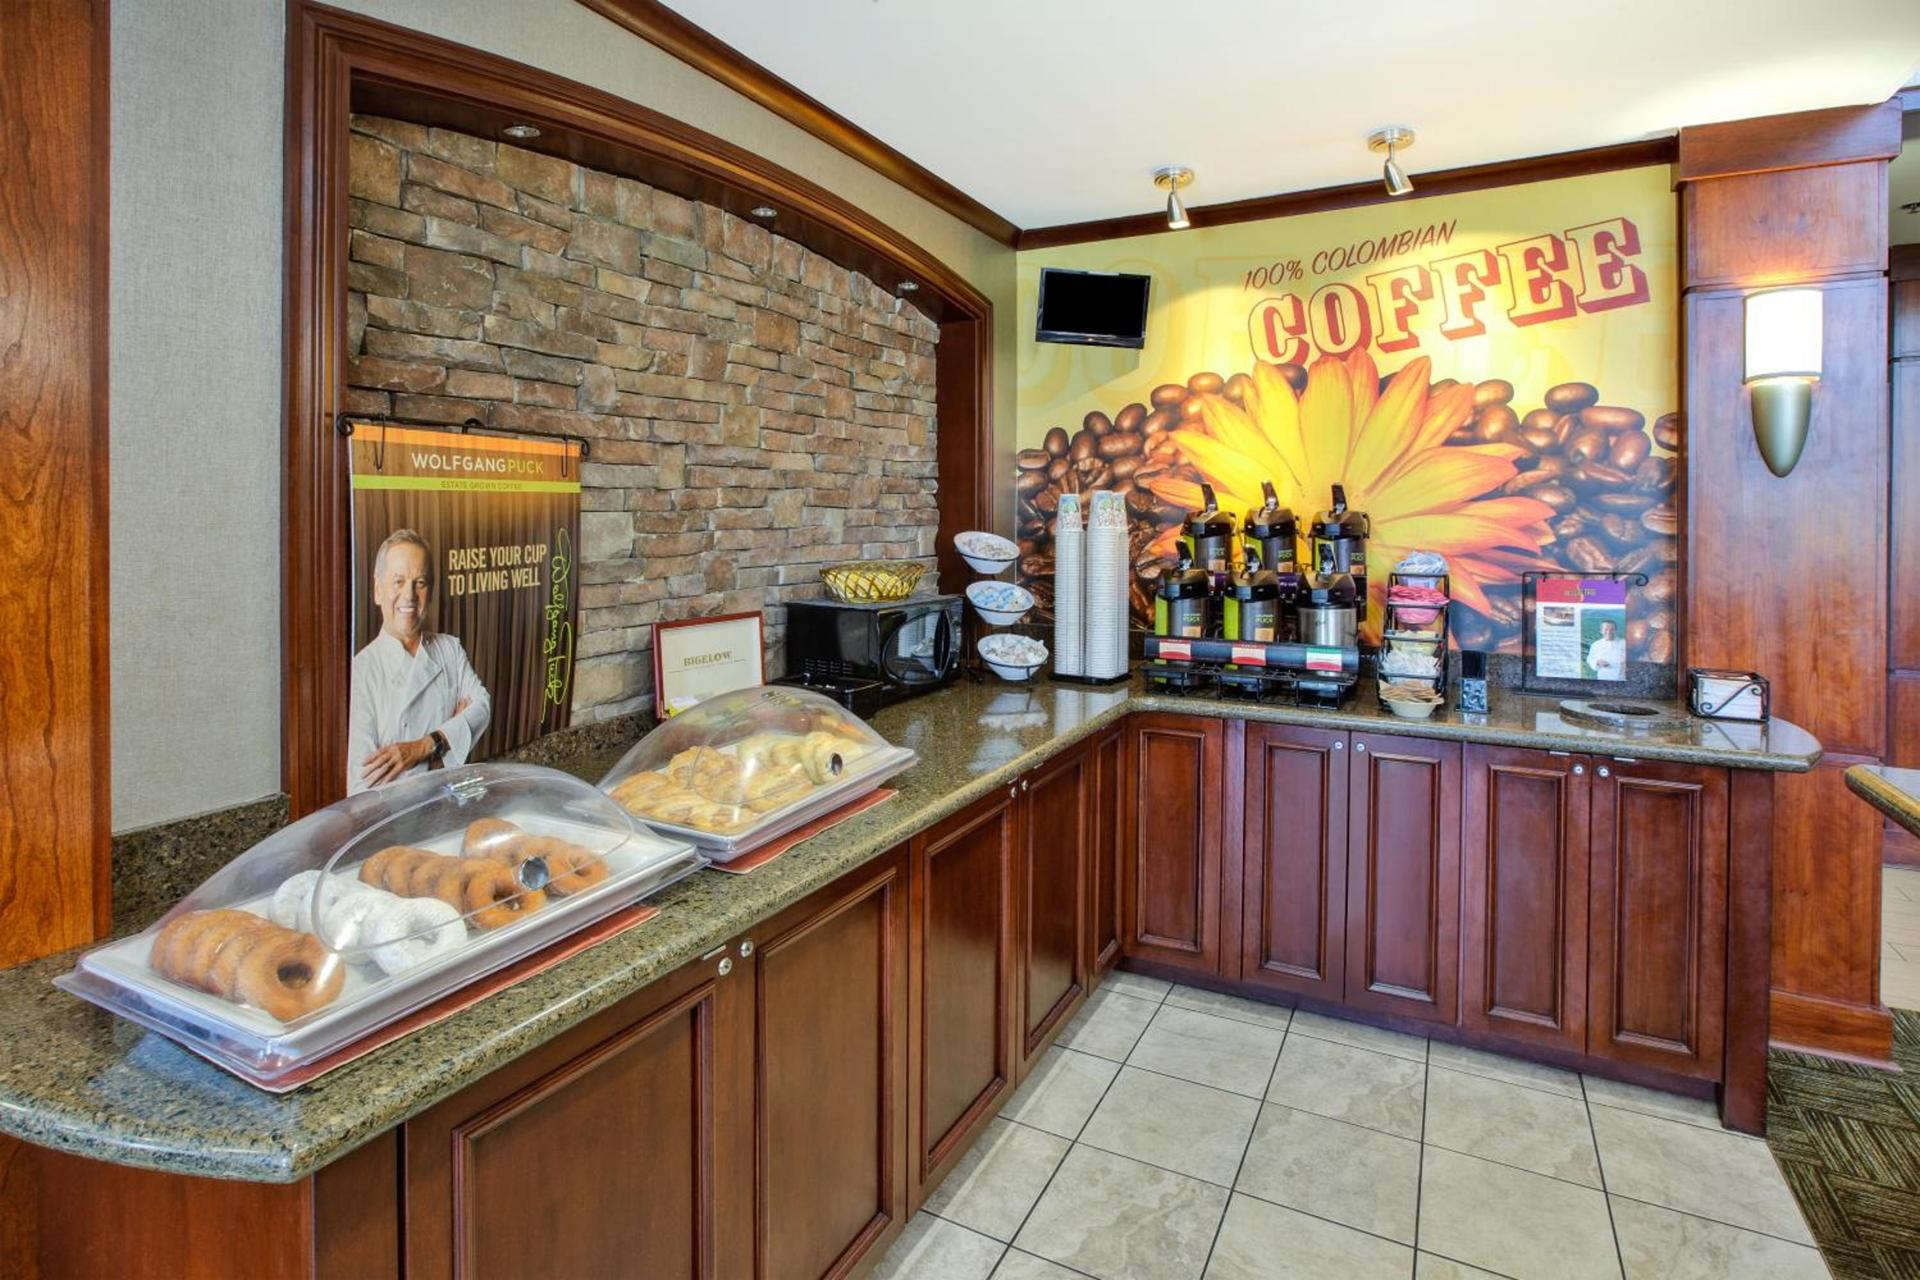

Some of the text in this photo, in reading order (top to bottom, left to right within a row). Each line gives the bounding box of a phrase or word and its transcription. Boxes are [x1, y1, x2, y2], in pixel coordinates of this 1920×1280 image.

[1244, 219, 1458, 291] 100% COLOMBIAN
[1248, 216, 1651, 366] COFFEE
[440, 480, 468, 489] ESTATE
[469, 481, 496, 489] GROWN
[448, 543, 547, 571] RAISE YOUR CUP
[448, 566, 541, 596] TO LIVING WELL
[683, 650, 732, 666] BIGELOW
